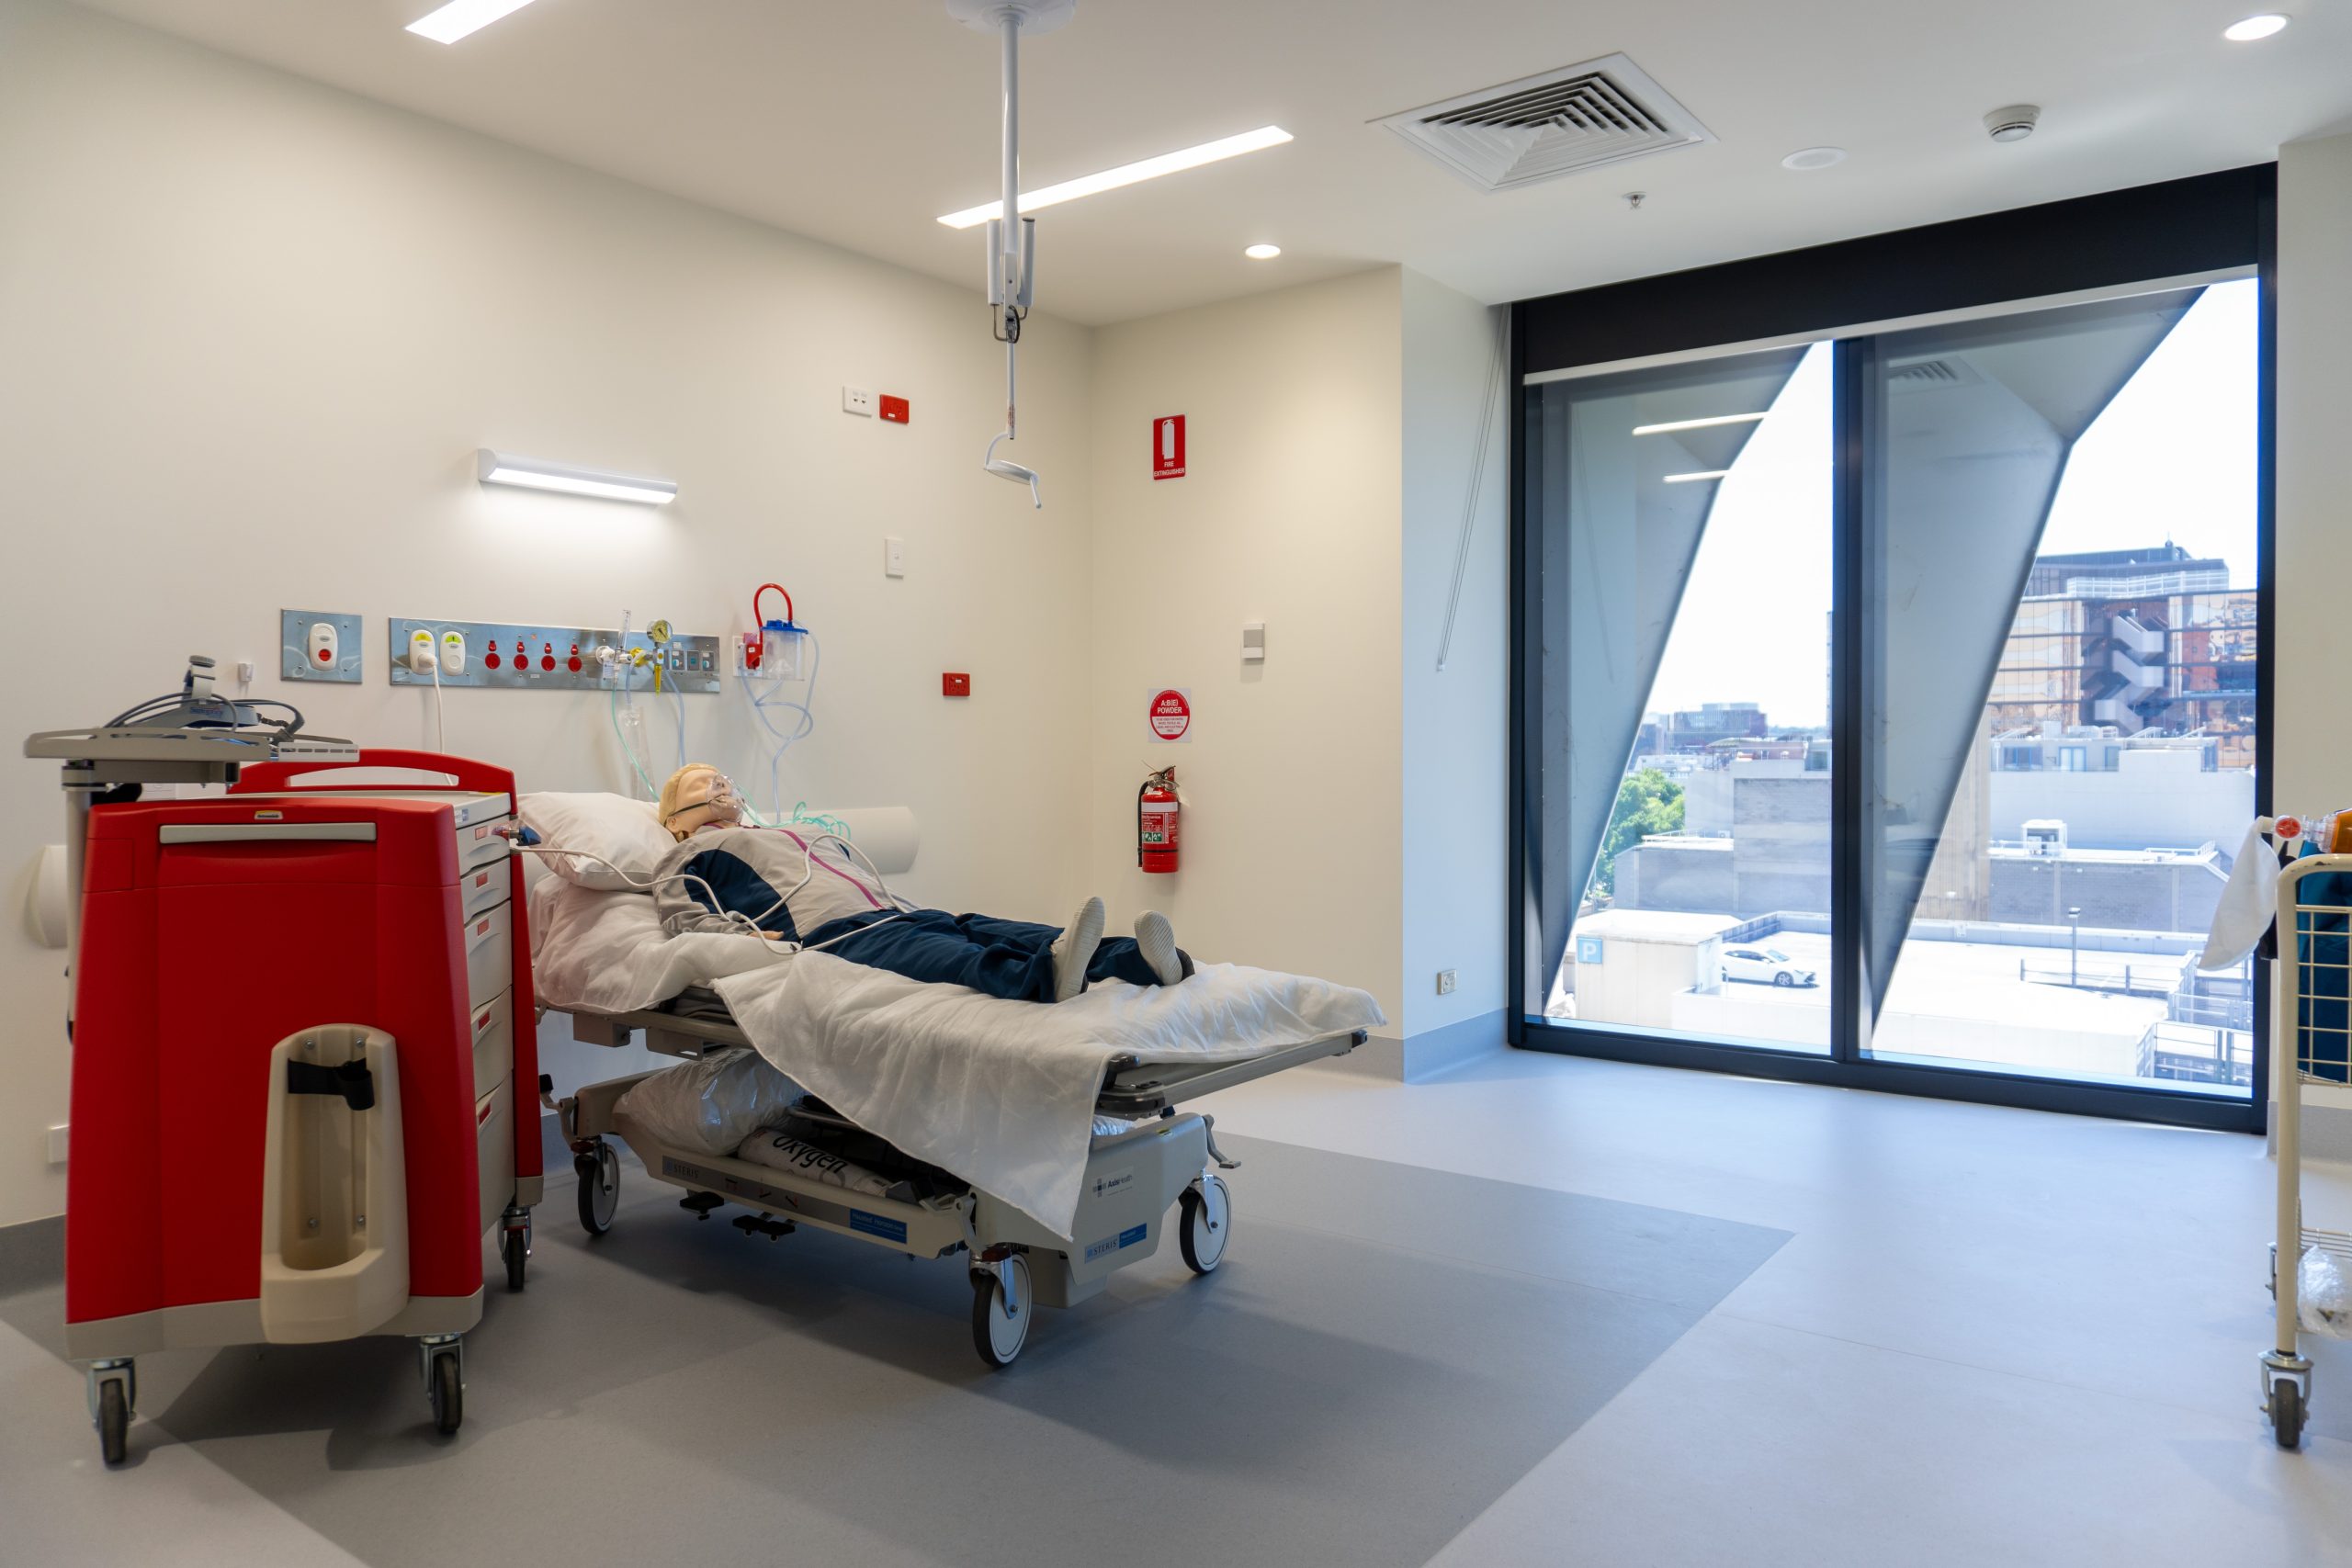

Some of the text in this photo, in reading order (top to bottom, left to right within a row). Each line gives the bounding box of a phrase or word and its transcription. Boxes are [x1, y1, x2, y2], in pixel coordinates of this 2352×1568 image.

[1154, 468, 1185, 477] EXTINGUISHER
[1582, 942, 1597, 962] P
[773, 1136, 847, 1174] Oxygen
[1093, 1240, 1117, 1256] STERIS
